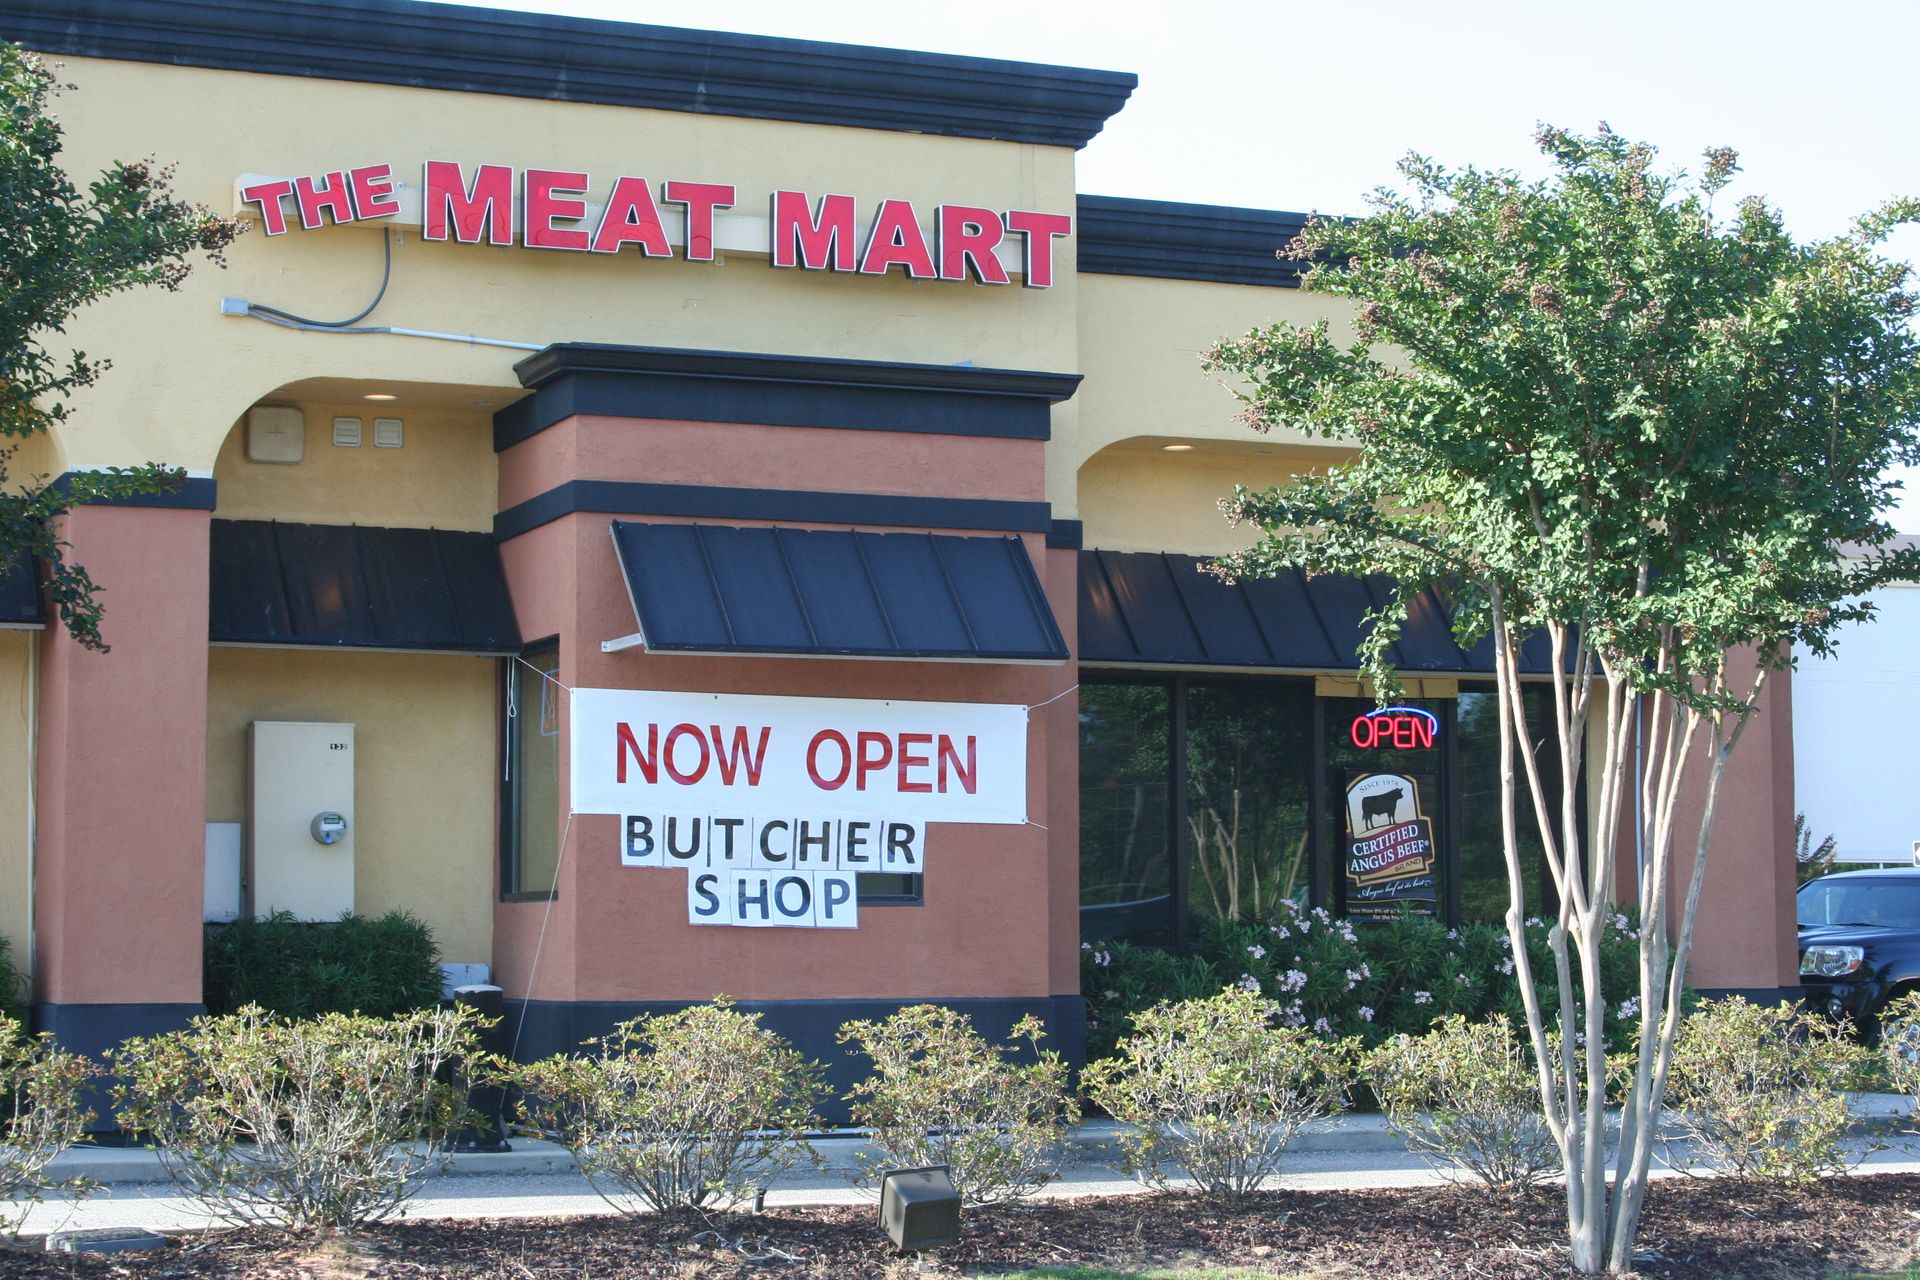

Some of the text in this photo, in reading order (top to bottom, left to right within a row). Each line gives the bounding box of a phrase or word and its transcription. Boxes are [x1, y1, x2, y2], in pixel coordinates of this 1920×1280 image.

[241, 160, 1072, 288] THE MEAT MART
[1351, 715, 1433, 748] OPEN
[616, 722, 977, 795] NOW OPEN
[626, 815, 916, 864] BUTCHER
[1352, 824, 1418, 856] CERTIFIED
[1350, 849, 1395, 872] ANGUS
[1394, 859, 1421, 872] BRAND
[694, 874, 850, 919] SHOP
[1357, 886, 1384, 900] Angus
[1385, 881, 1400, 896] beef
